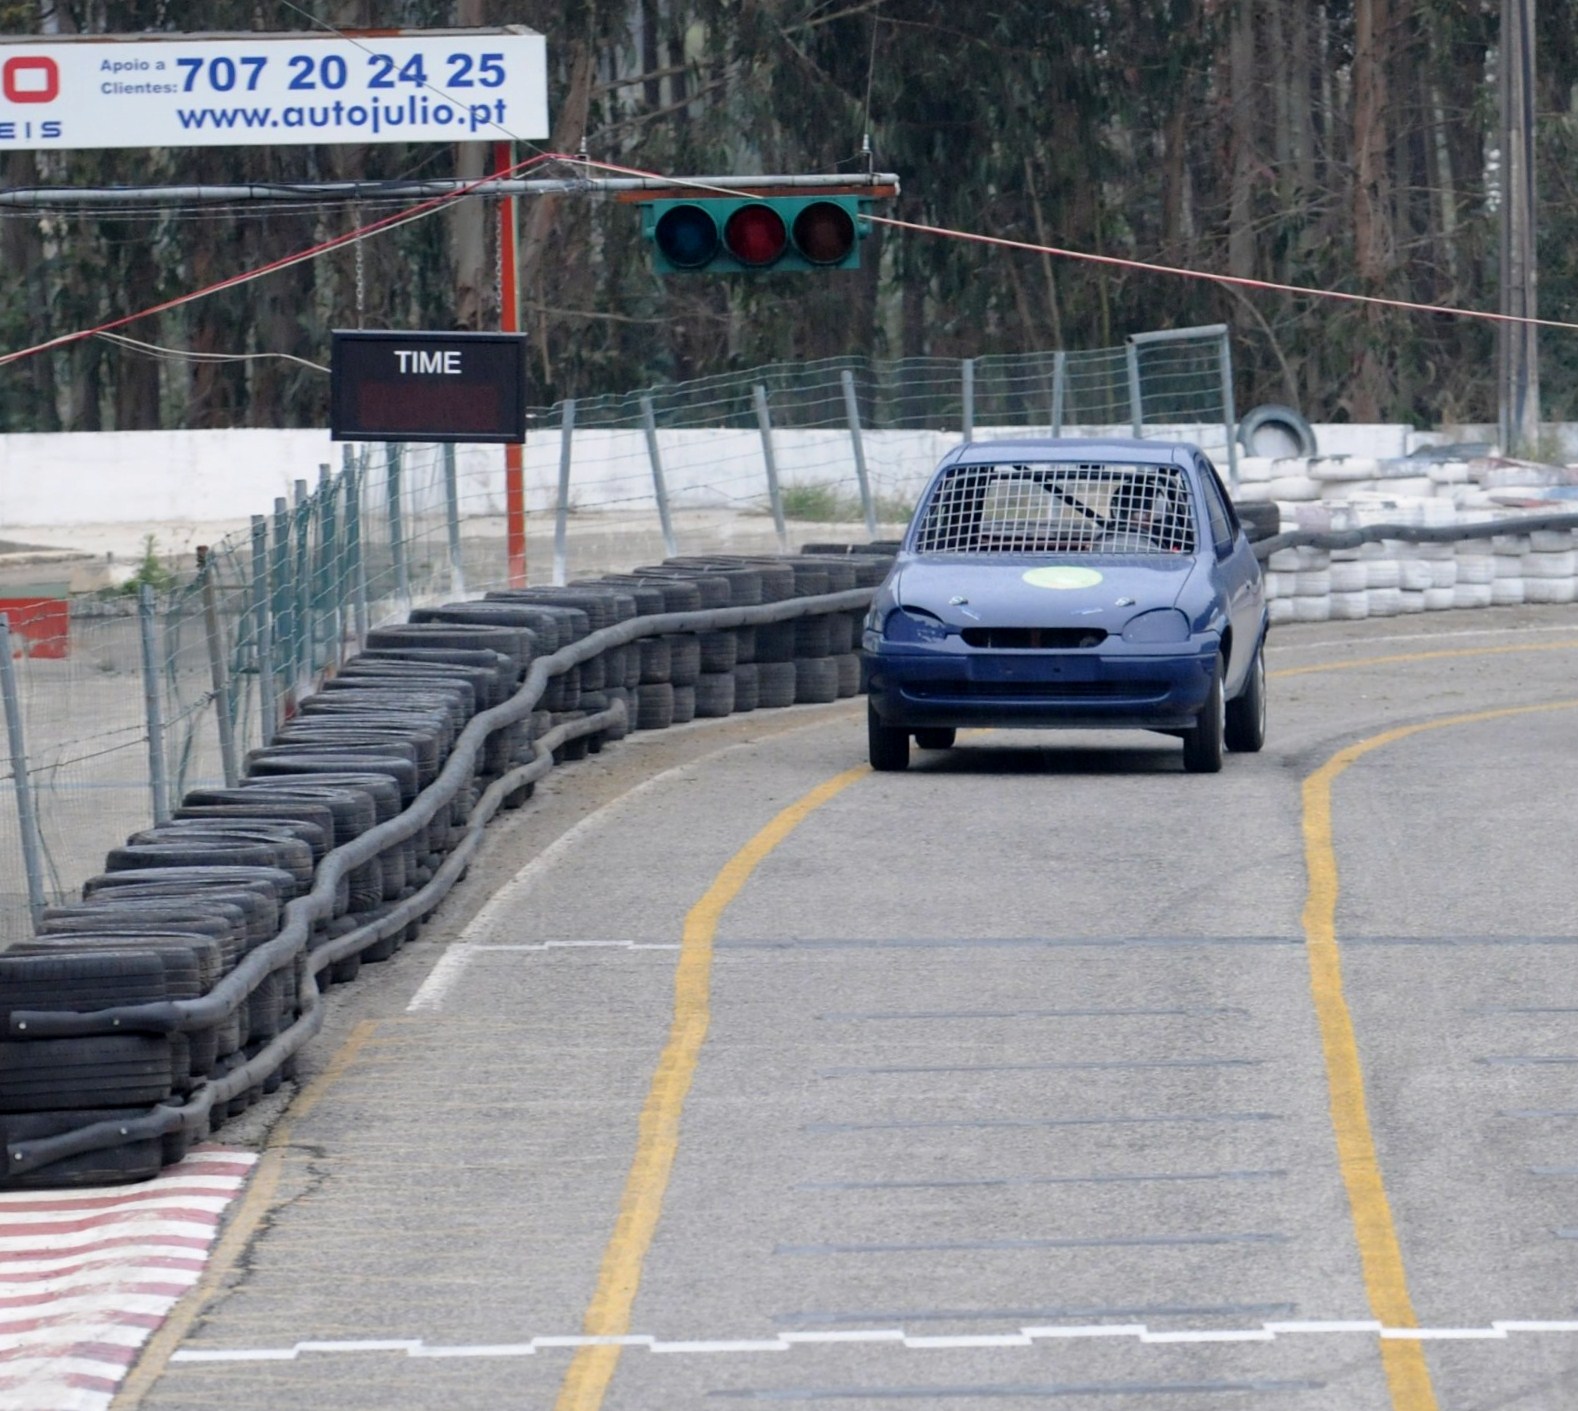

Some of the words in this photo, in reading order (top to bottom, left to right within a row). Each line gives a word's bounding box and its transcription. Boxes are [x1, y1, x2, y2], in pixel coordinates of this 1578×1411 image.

[100, 59, 150, 74] Apoio
[155, 61, 166, 71] a
[176, 56, 268, 92] 707
[287, 54, 348, 91] 20
[367, 53, 428, 89] 24
[445, 53, 507, 89] 25
[101, 81, 178, 95] Clientes:
[176, 95, 508, 133] www.autojulio.pt
[393, 350, 463, 374] TIME
